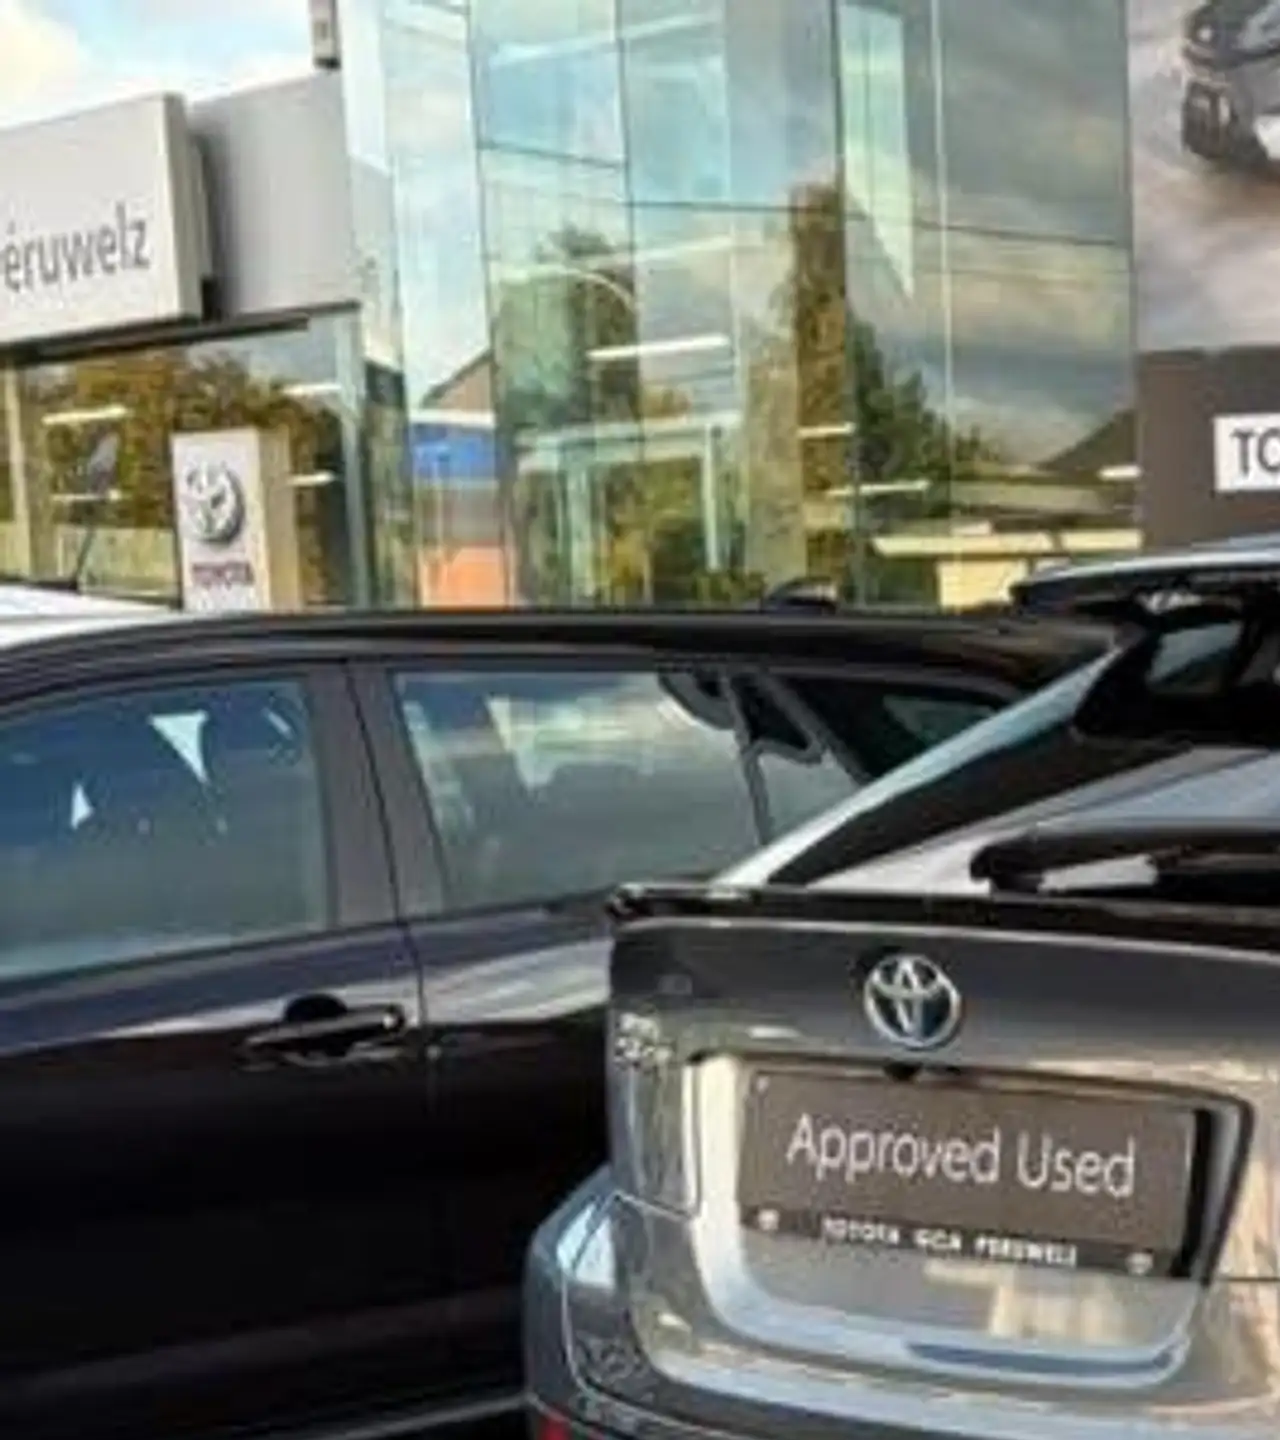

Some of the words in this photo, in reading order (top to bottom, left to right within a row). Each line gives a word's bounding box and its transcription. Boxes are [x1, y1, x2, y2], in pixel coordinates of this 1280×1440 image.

[1, 201, 151, 293] éruwelz
[785, 1111, 1001, 1184] Approved
[1016, 1131, 1136, 1198] Used
